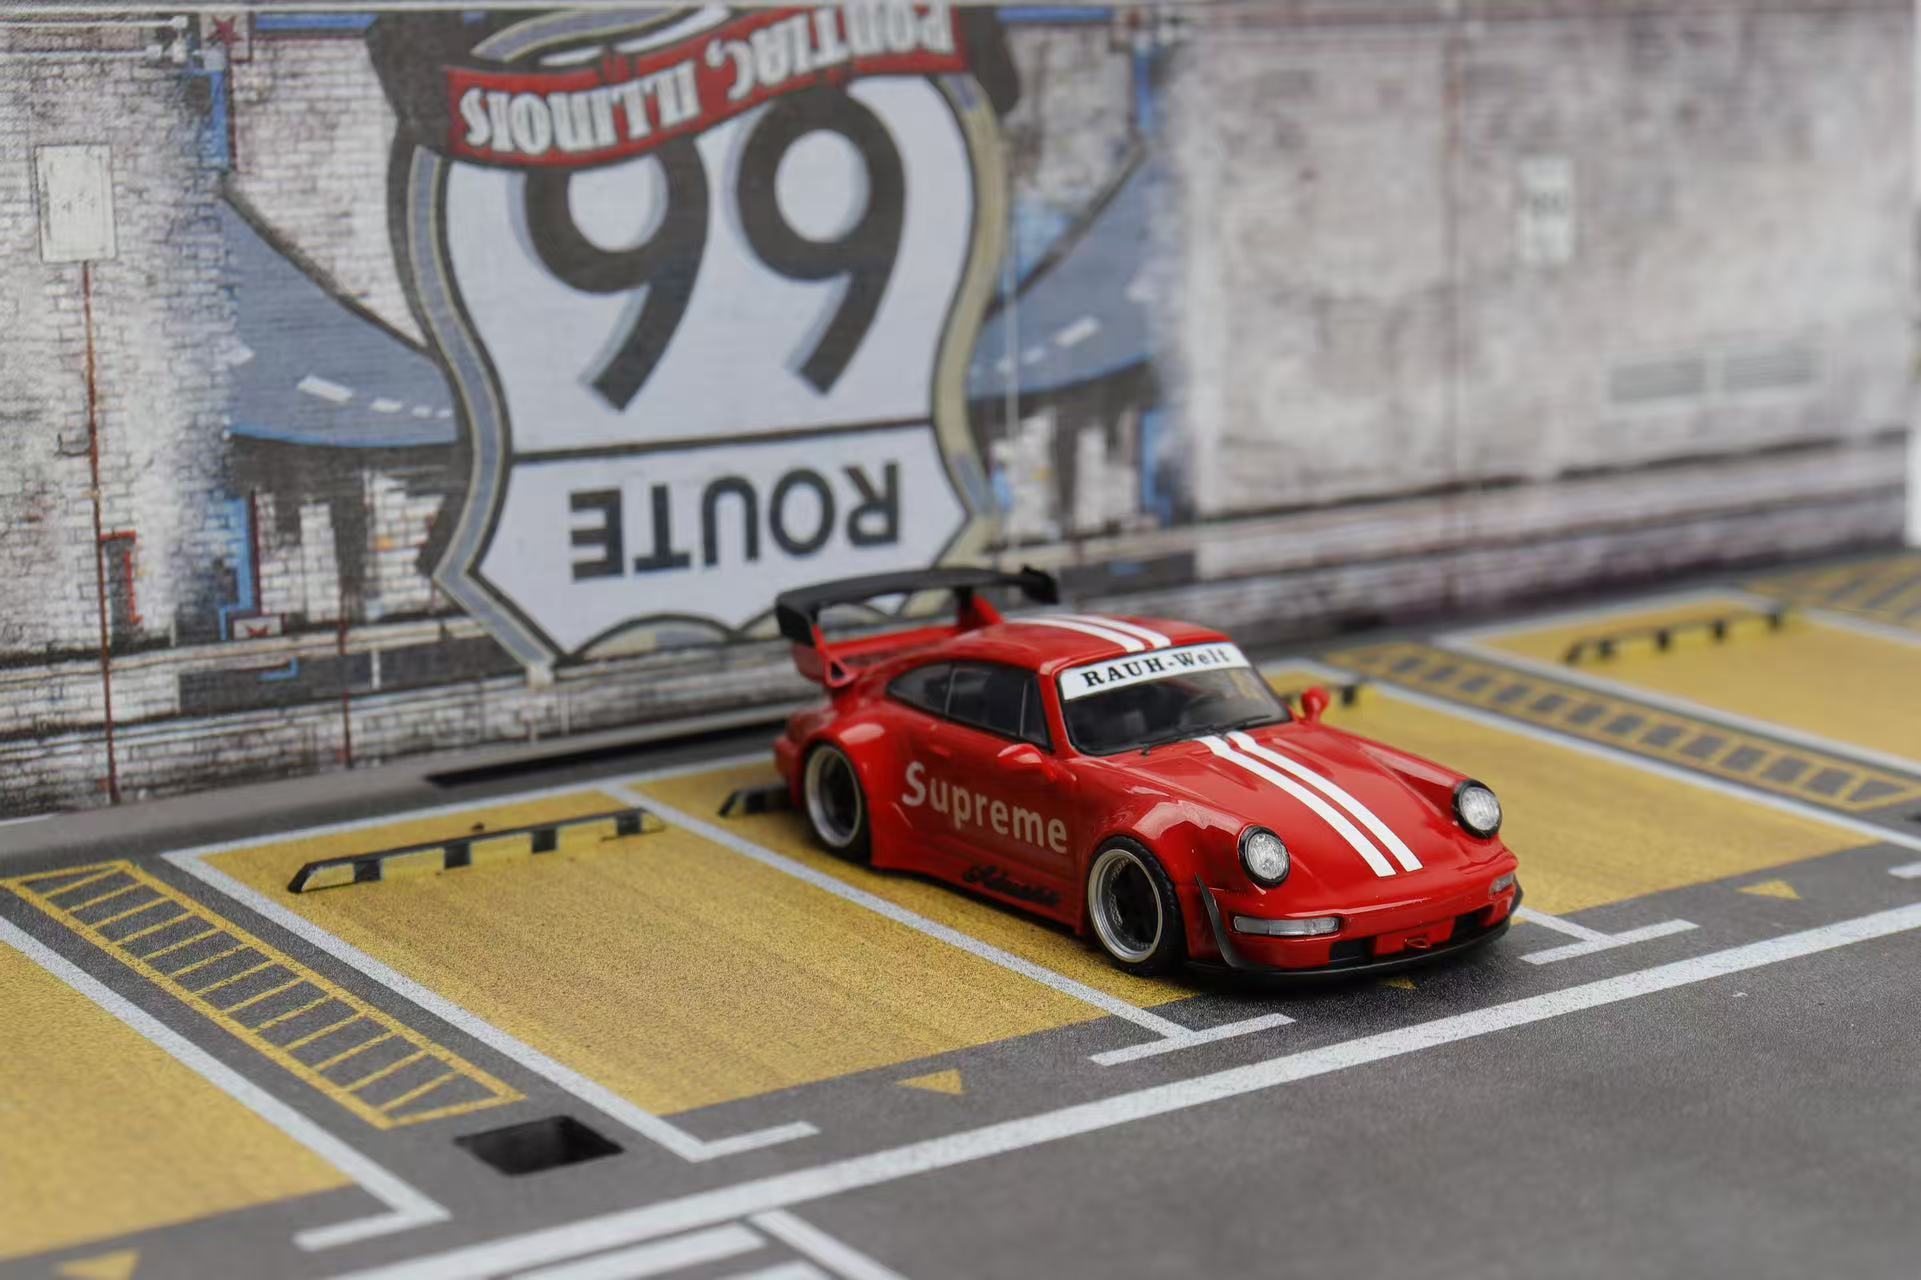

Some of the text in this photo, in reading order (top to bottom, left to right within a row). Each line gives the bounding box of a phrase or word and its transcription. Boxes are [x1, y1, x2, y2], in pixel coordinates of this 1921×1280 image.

[459, 60, 701, 155] ILLINOIS
[518, 86, 907, 413] 66
[568, 460, 901, 583] ROUTE
[1081, 648, 1231, 688] RAUH-Welt
[902, 760, 1067, 854] Supreme
